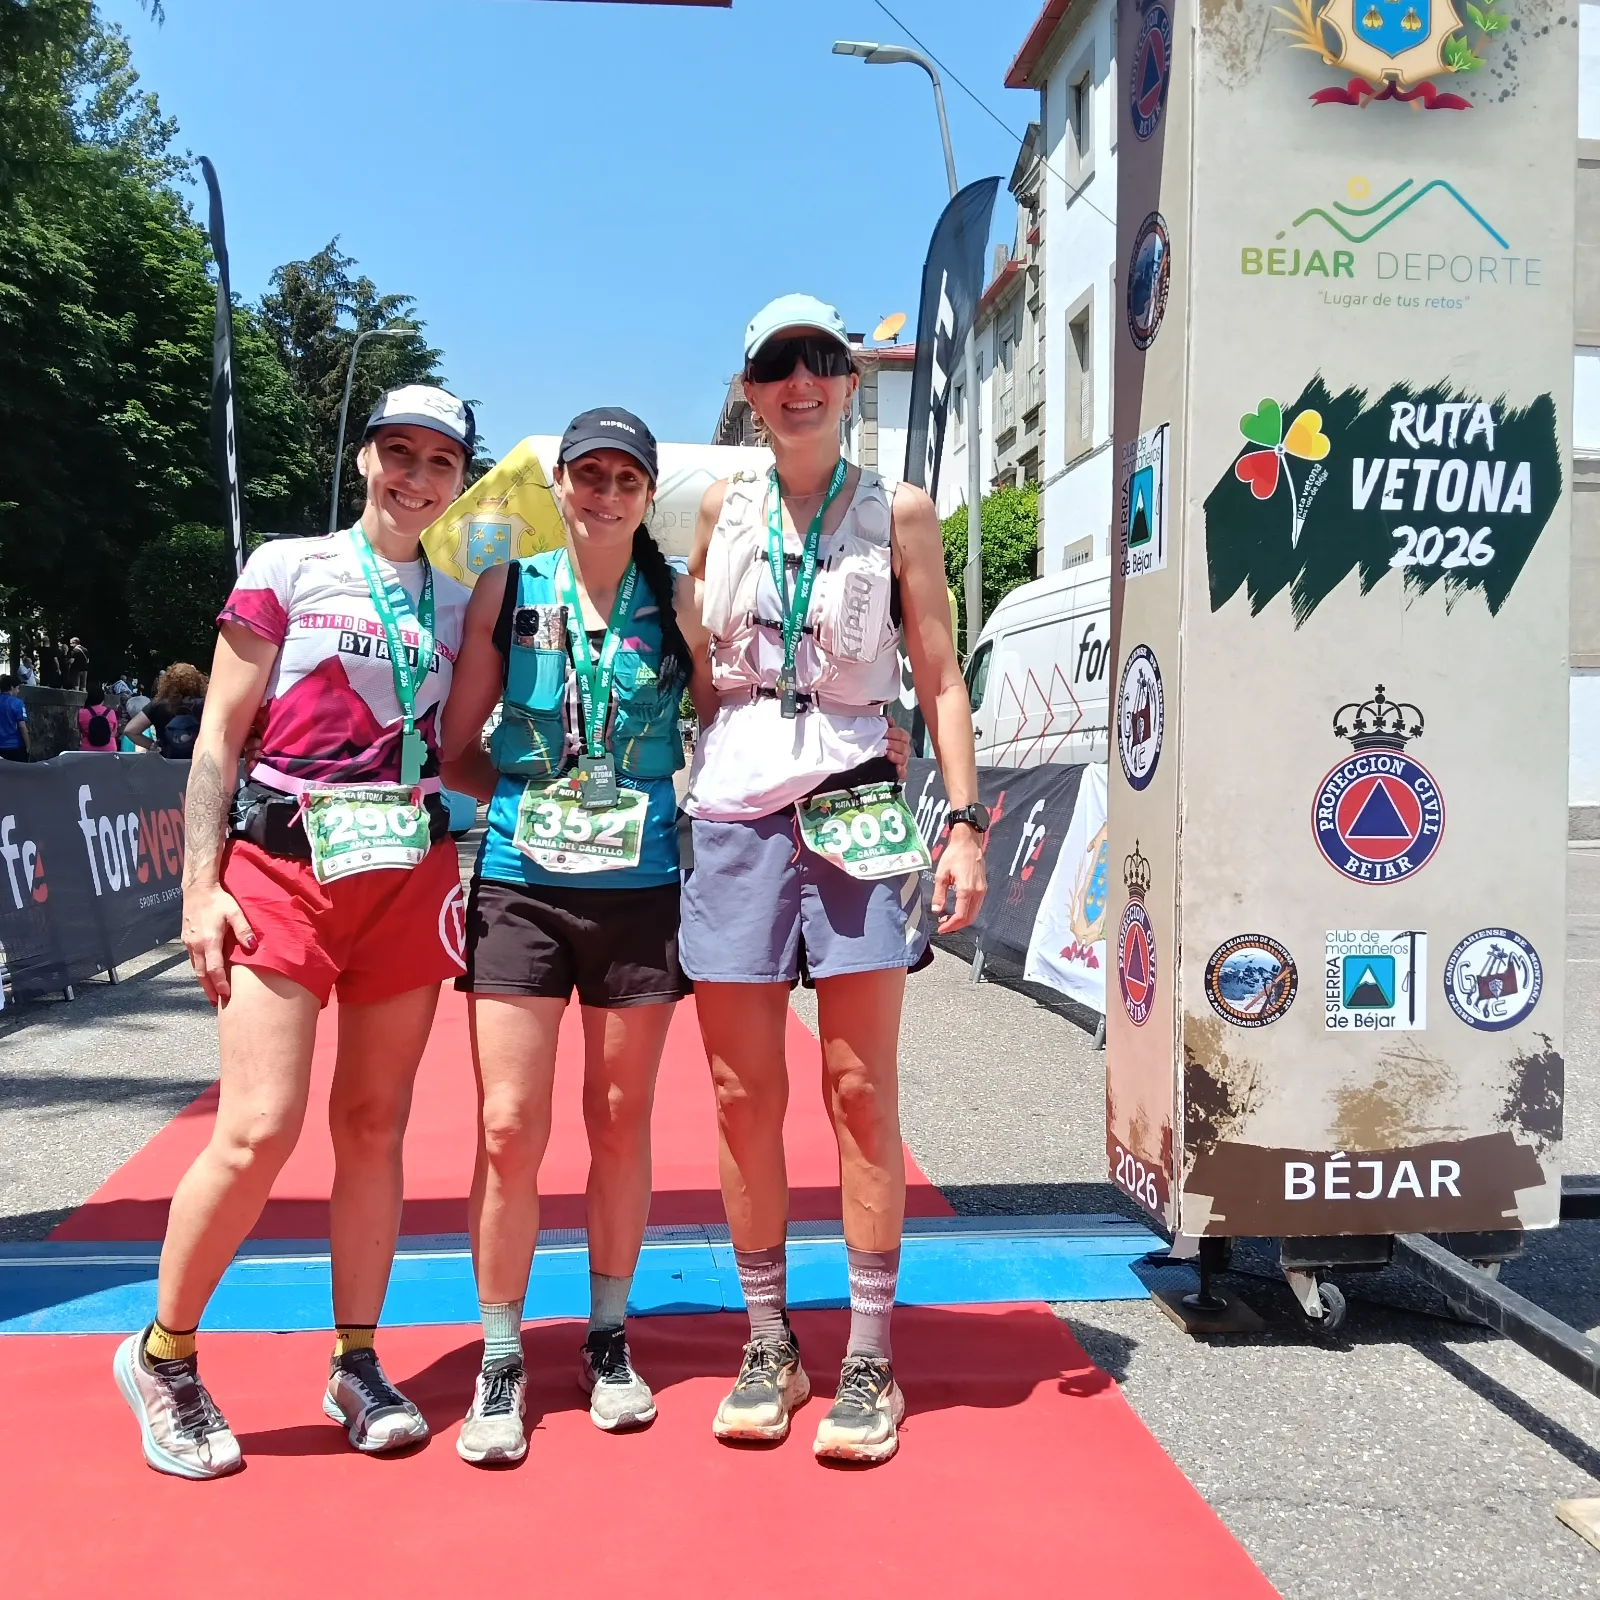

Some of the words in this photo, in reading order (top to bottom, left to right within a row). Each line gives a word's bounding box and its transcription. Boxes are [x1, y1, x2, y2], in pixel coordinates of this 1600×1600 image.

[1241, 231, 1355, 279] BÉJAR
[1377, 252, 1542, 287] DEPORTE
[1317, 290, 1367, 309] "Lugar
[1372, 291, 1392, 306] de
[1397, 294, 1420, 308] tus
[1424, 295, 1470, 310] retos"
[1389, 401, 1497, 451] RUTA
[1138, 434, 1147, 453] de
[1297, 498, 1307, 518] ruta
[1302, 463, 1322, 496] vetona
[1353, 457, 1532, 514] VETONA
[1120, 478, 1129, 556] SIERRA
[808, 532, 818, 549] RUTA
[1389, 526, 1495, 568] 2026
[803, 549, 815, 579] VETONA
[1132, 551, 1153, 575] Béjar
[800, 580, 810, 599] 2026
[300, 616, 353, 629] CENTRO
[794, 612, 803, 630] RUTA
[340, 631, 370, 653] BY
[392, 639, 407, 668] VETONA
[399, 670, 409, 688] 2026
[580, 674, 590, 691] 2026
[601, 670, 610, 688] 2026
[596, 701, 605, 719] RUTA
[593, 719, 604, 748] VETONA
[835, 798, 851, 809] RUTA
[1318, 756, 1406, 832] PROTECCION
[1414, 777, 1440, 836] CIVIL
[324, 805, 418, 846] 290
[533, 802, 627, 847] 352
[821, 808, 907, 854] 303
[559, 841, 578, 851] DEL
[579, 843, 624, 857] CASTILLO
[857, 848, 886, 859] CARLA
[1343, 856, 1414, 880] BEJAR
[139, 893, 160, 909] SPORTS
[161, 887, 183, 902] EXPER
[1325, 930, 1357, 942] club
[1360, 930, 1380, 943] de
[1325, 942, 1409, 955] montañeros
[1513, 935, 1528, 948] DE
[1146, 929, 1156, 985] CIVIL
[1209, 945, 1228, 966] GRUPO
[1225, 935, 1259, 949] BEJARANO
[1259, 936, 1269, 945] DE
[1445, 929, 1507, 986] CANDELARIENSE
[1325, 956, 1341, 1013] SIERRA
[1126, 994, 1147, 1022] BEJAR
[1212, 1001, 1262, 1028] ANIVERSARIO
[1325, 1013, 1349, 1029] de
[1354, 1012, 1396, 1031] Béjar
[1448, 993, 1475, 1024] GRUPO
[1115, 1145, 1158, 1210] 2026
[1283, 1151, 1462, 1201] BÉJAR
